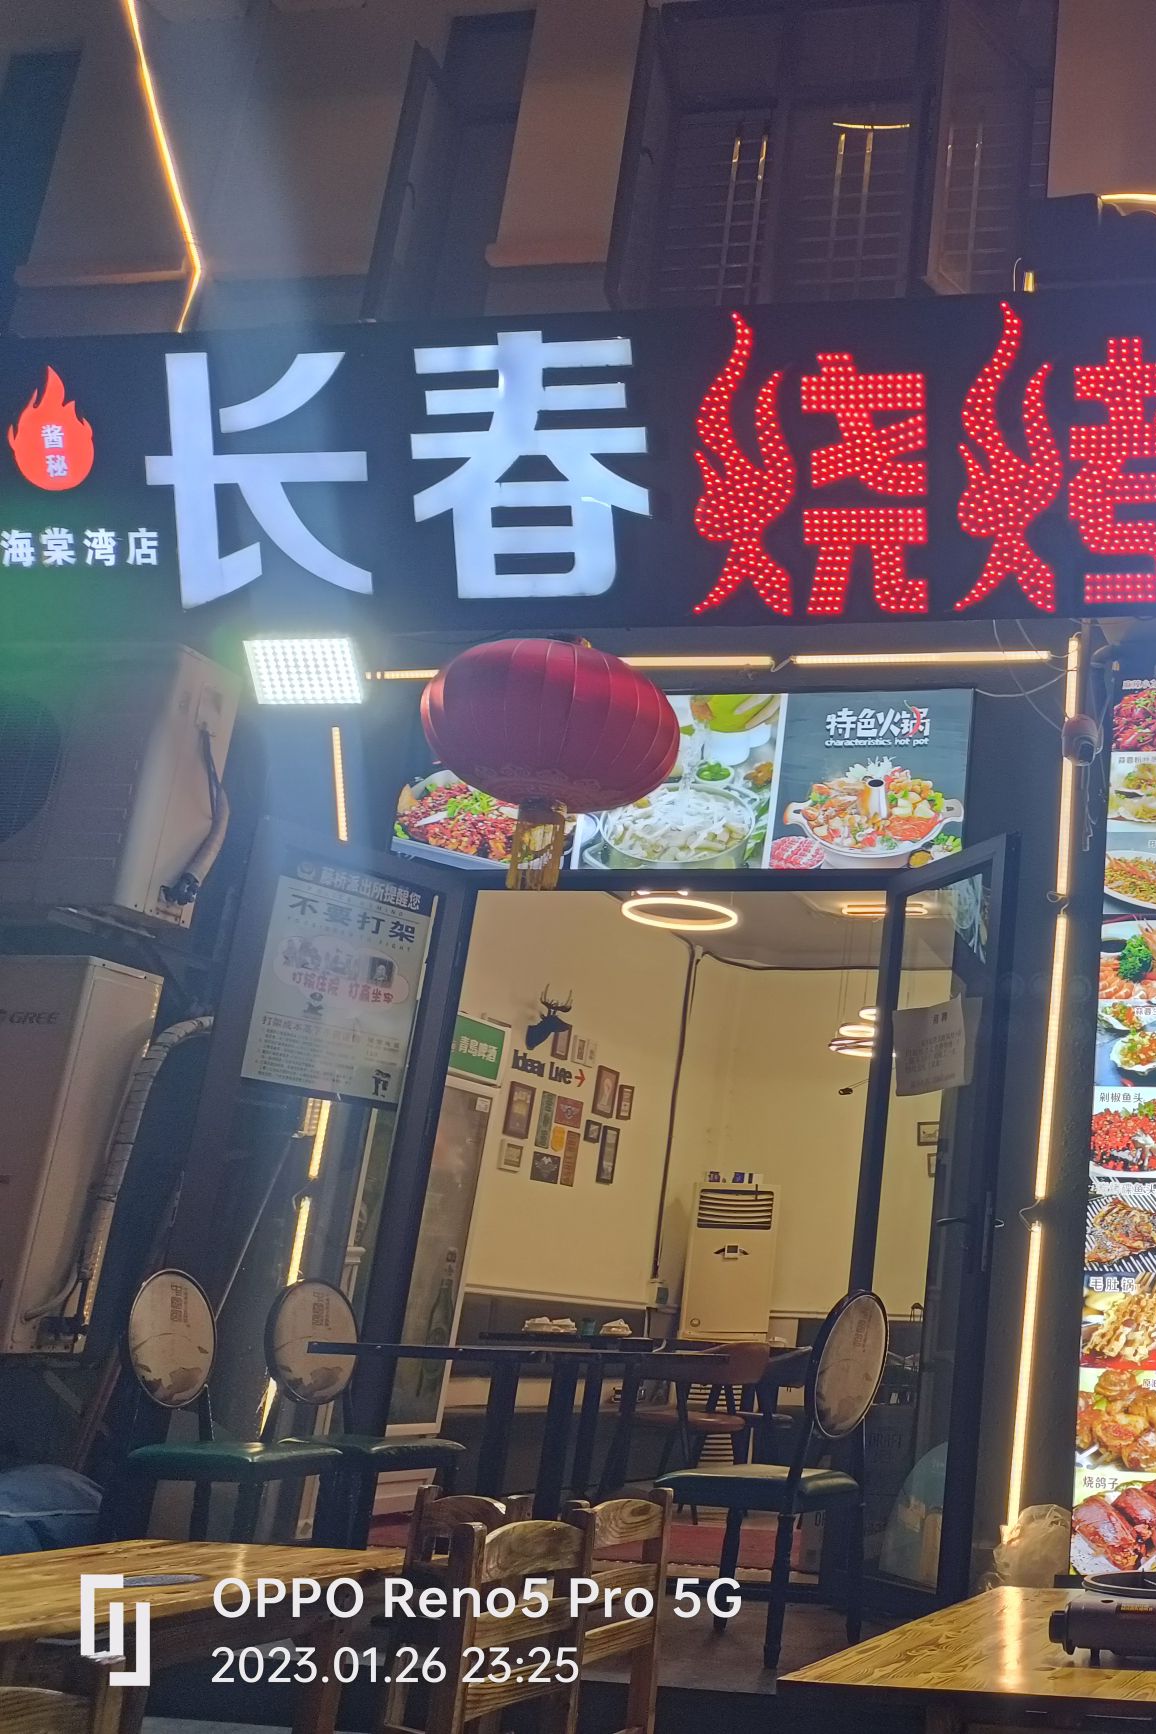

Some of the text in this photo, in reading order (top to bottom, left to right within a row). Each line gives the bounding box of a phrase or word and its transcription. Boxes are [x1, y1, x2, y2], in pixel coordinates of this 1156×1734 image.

[41, 424, 68, 478] 酱秘
[1, 527, 159, 567] 海棠湾店
[825, 707, 931, 739] 特色火锅
[825, 738, 929, 748] characteristics hot pot
[289, 894, 415, 943] 不要打架
[459, 1035, 499, 1063] 青岛啤酒
[1099, 1092, 1144, 1103] 剁椒鱼头
[1089, 1277, 1135, 1291] 毛肚锅
[1082, 1476, 1119, 1489] 烧鸽子
